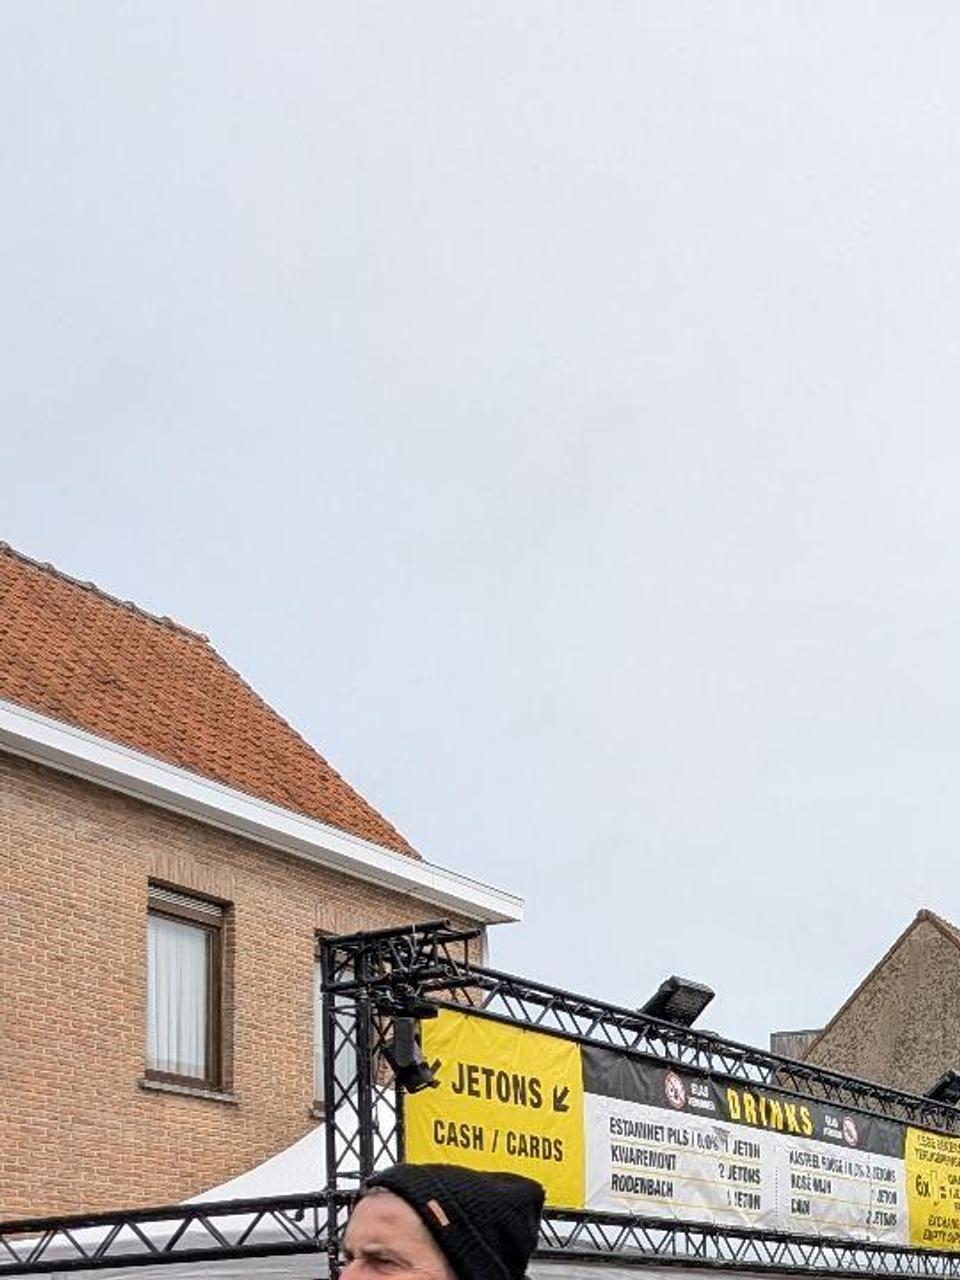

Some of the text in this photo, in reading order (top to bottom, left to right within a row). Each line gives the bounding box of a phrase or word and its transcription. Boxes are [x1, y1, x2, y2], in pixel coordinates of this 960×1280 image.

[452, 1062, 543, 1109] JETONS
[726, 1087, 814, 1136] DRINKS
[433, 1119, 564, 1162] CASH / CARDS
[667, 1127, 689, 1147] PILS
[732, 1139, 761, 1159] JETON
[610, 1145, 677, 1171] KWAREMONT
[611, 1173, 674, 1199] RODENBACH
[727, 1164, 761, 1185] JETONS
